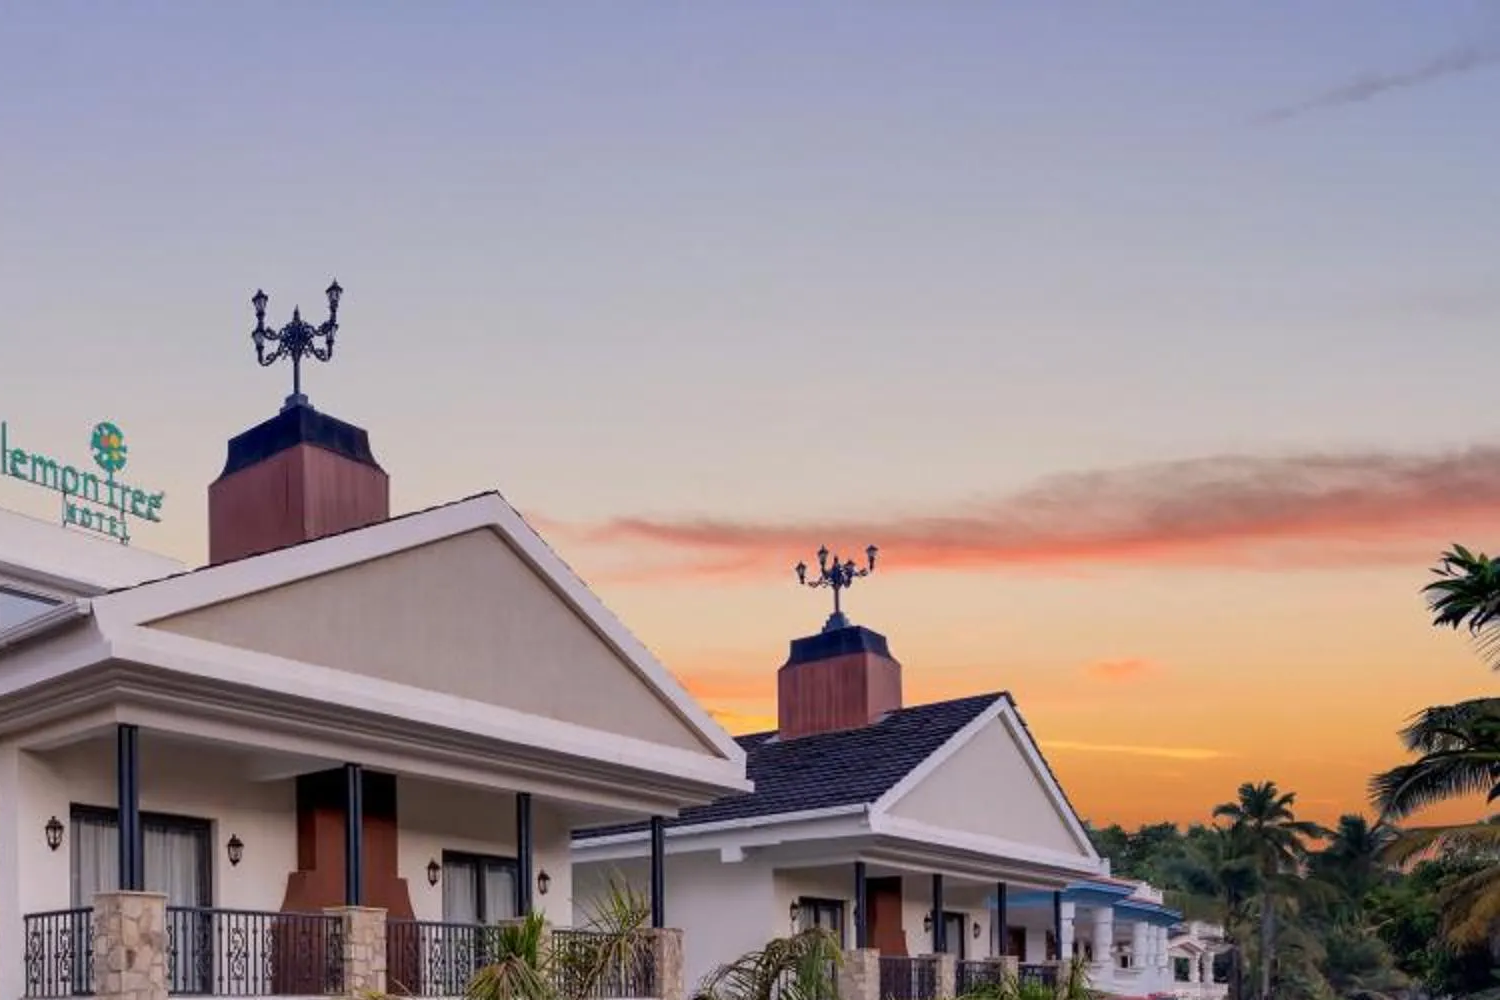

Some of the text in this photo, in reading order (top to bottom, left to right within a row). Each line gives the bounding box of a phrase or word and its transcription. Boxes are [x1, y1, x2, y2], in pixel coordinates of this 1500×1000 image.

[1, 421, 162, 523] lemon tree
[64, 502, 130, 544] HOTEL
